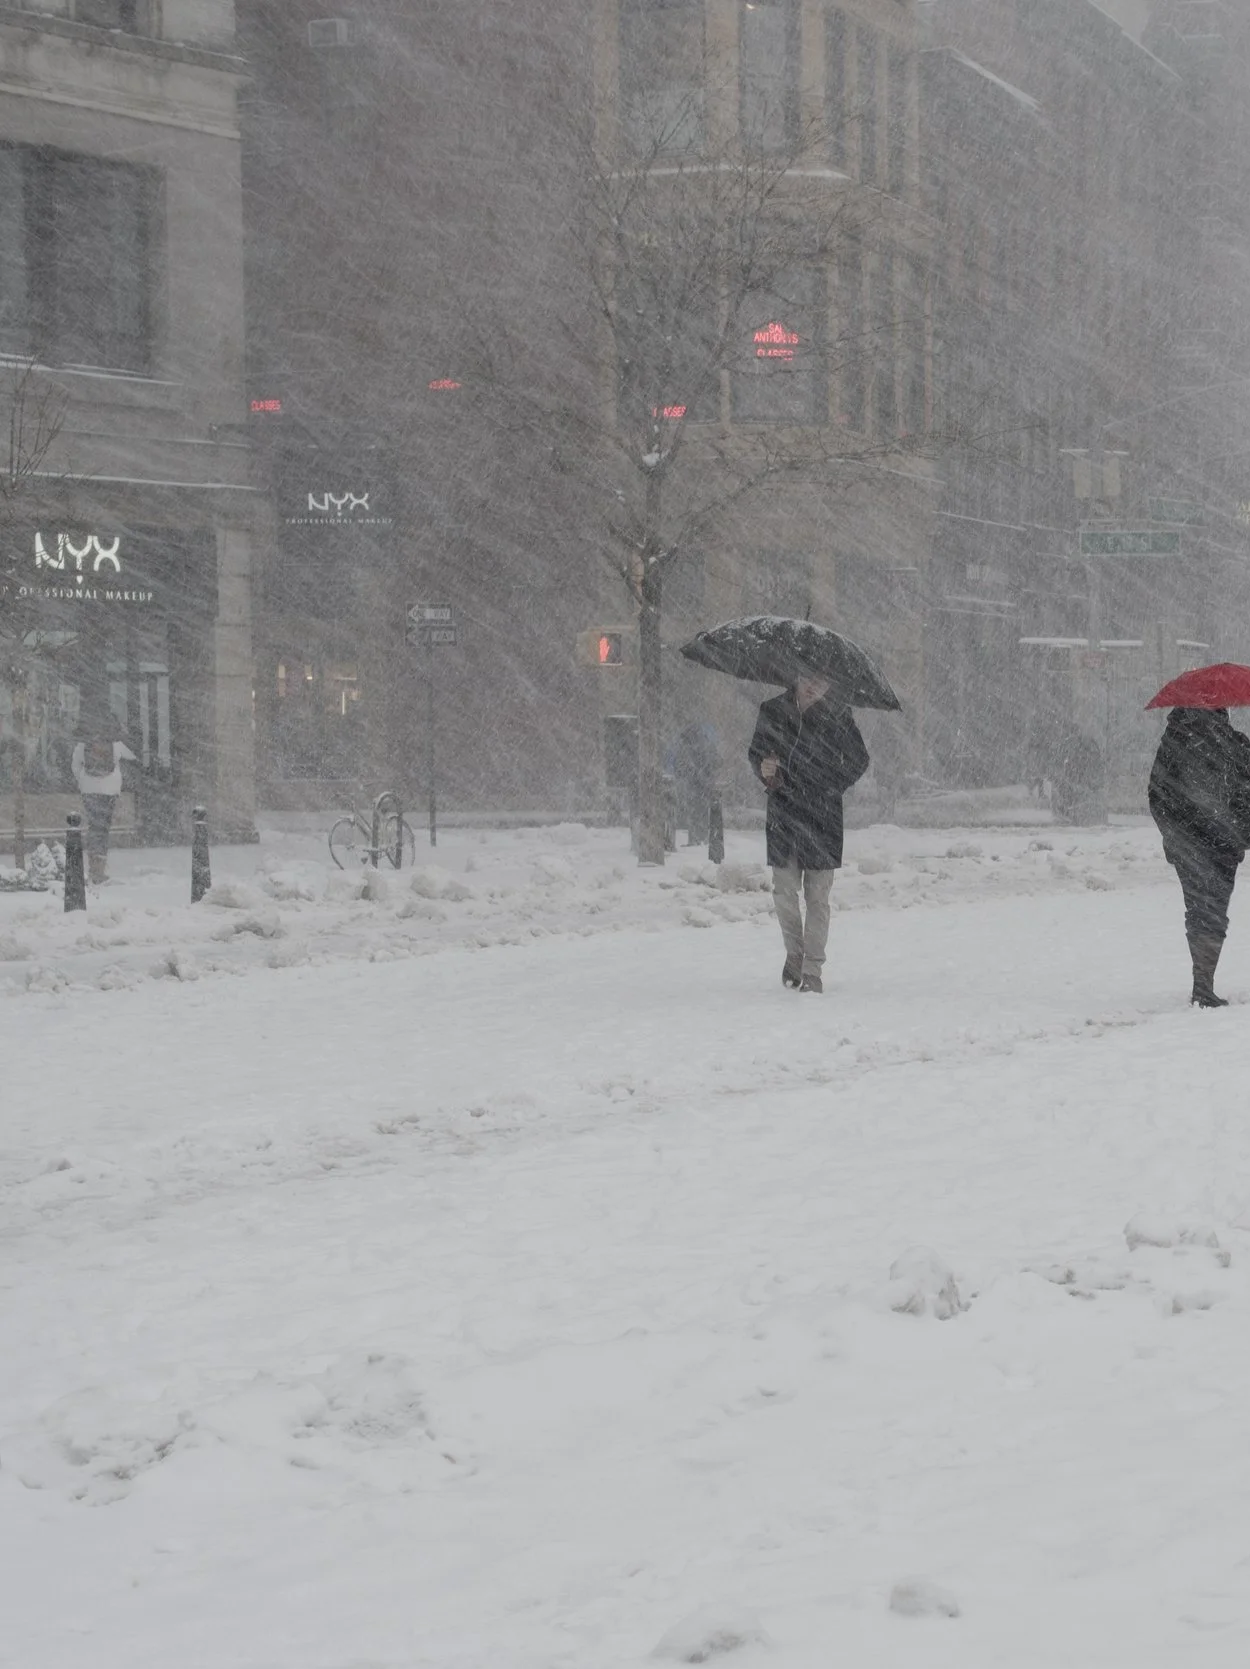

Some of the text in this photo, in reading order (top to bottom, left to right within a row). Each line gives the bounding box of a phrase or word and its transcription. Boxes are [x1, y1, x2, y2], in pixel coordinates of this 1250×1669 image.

[250, 400, 282, 412] CLASSES
[652, 405, 687, 418] ASSES
[307, 491, 370, 511] NYX
[34, 531, 122, 573] NYX
[2, 585, 153, 601] OFESSIONAL MAKEUP
